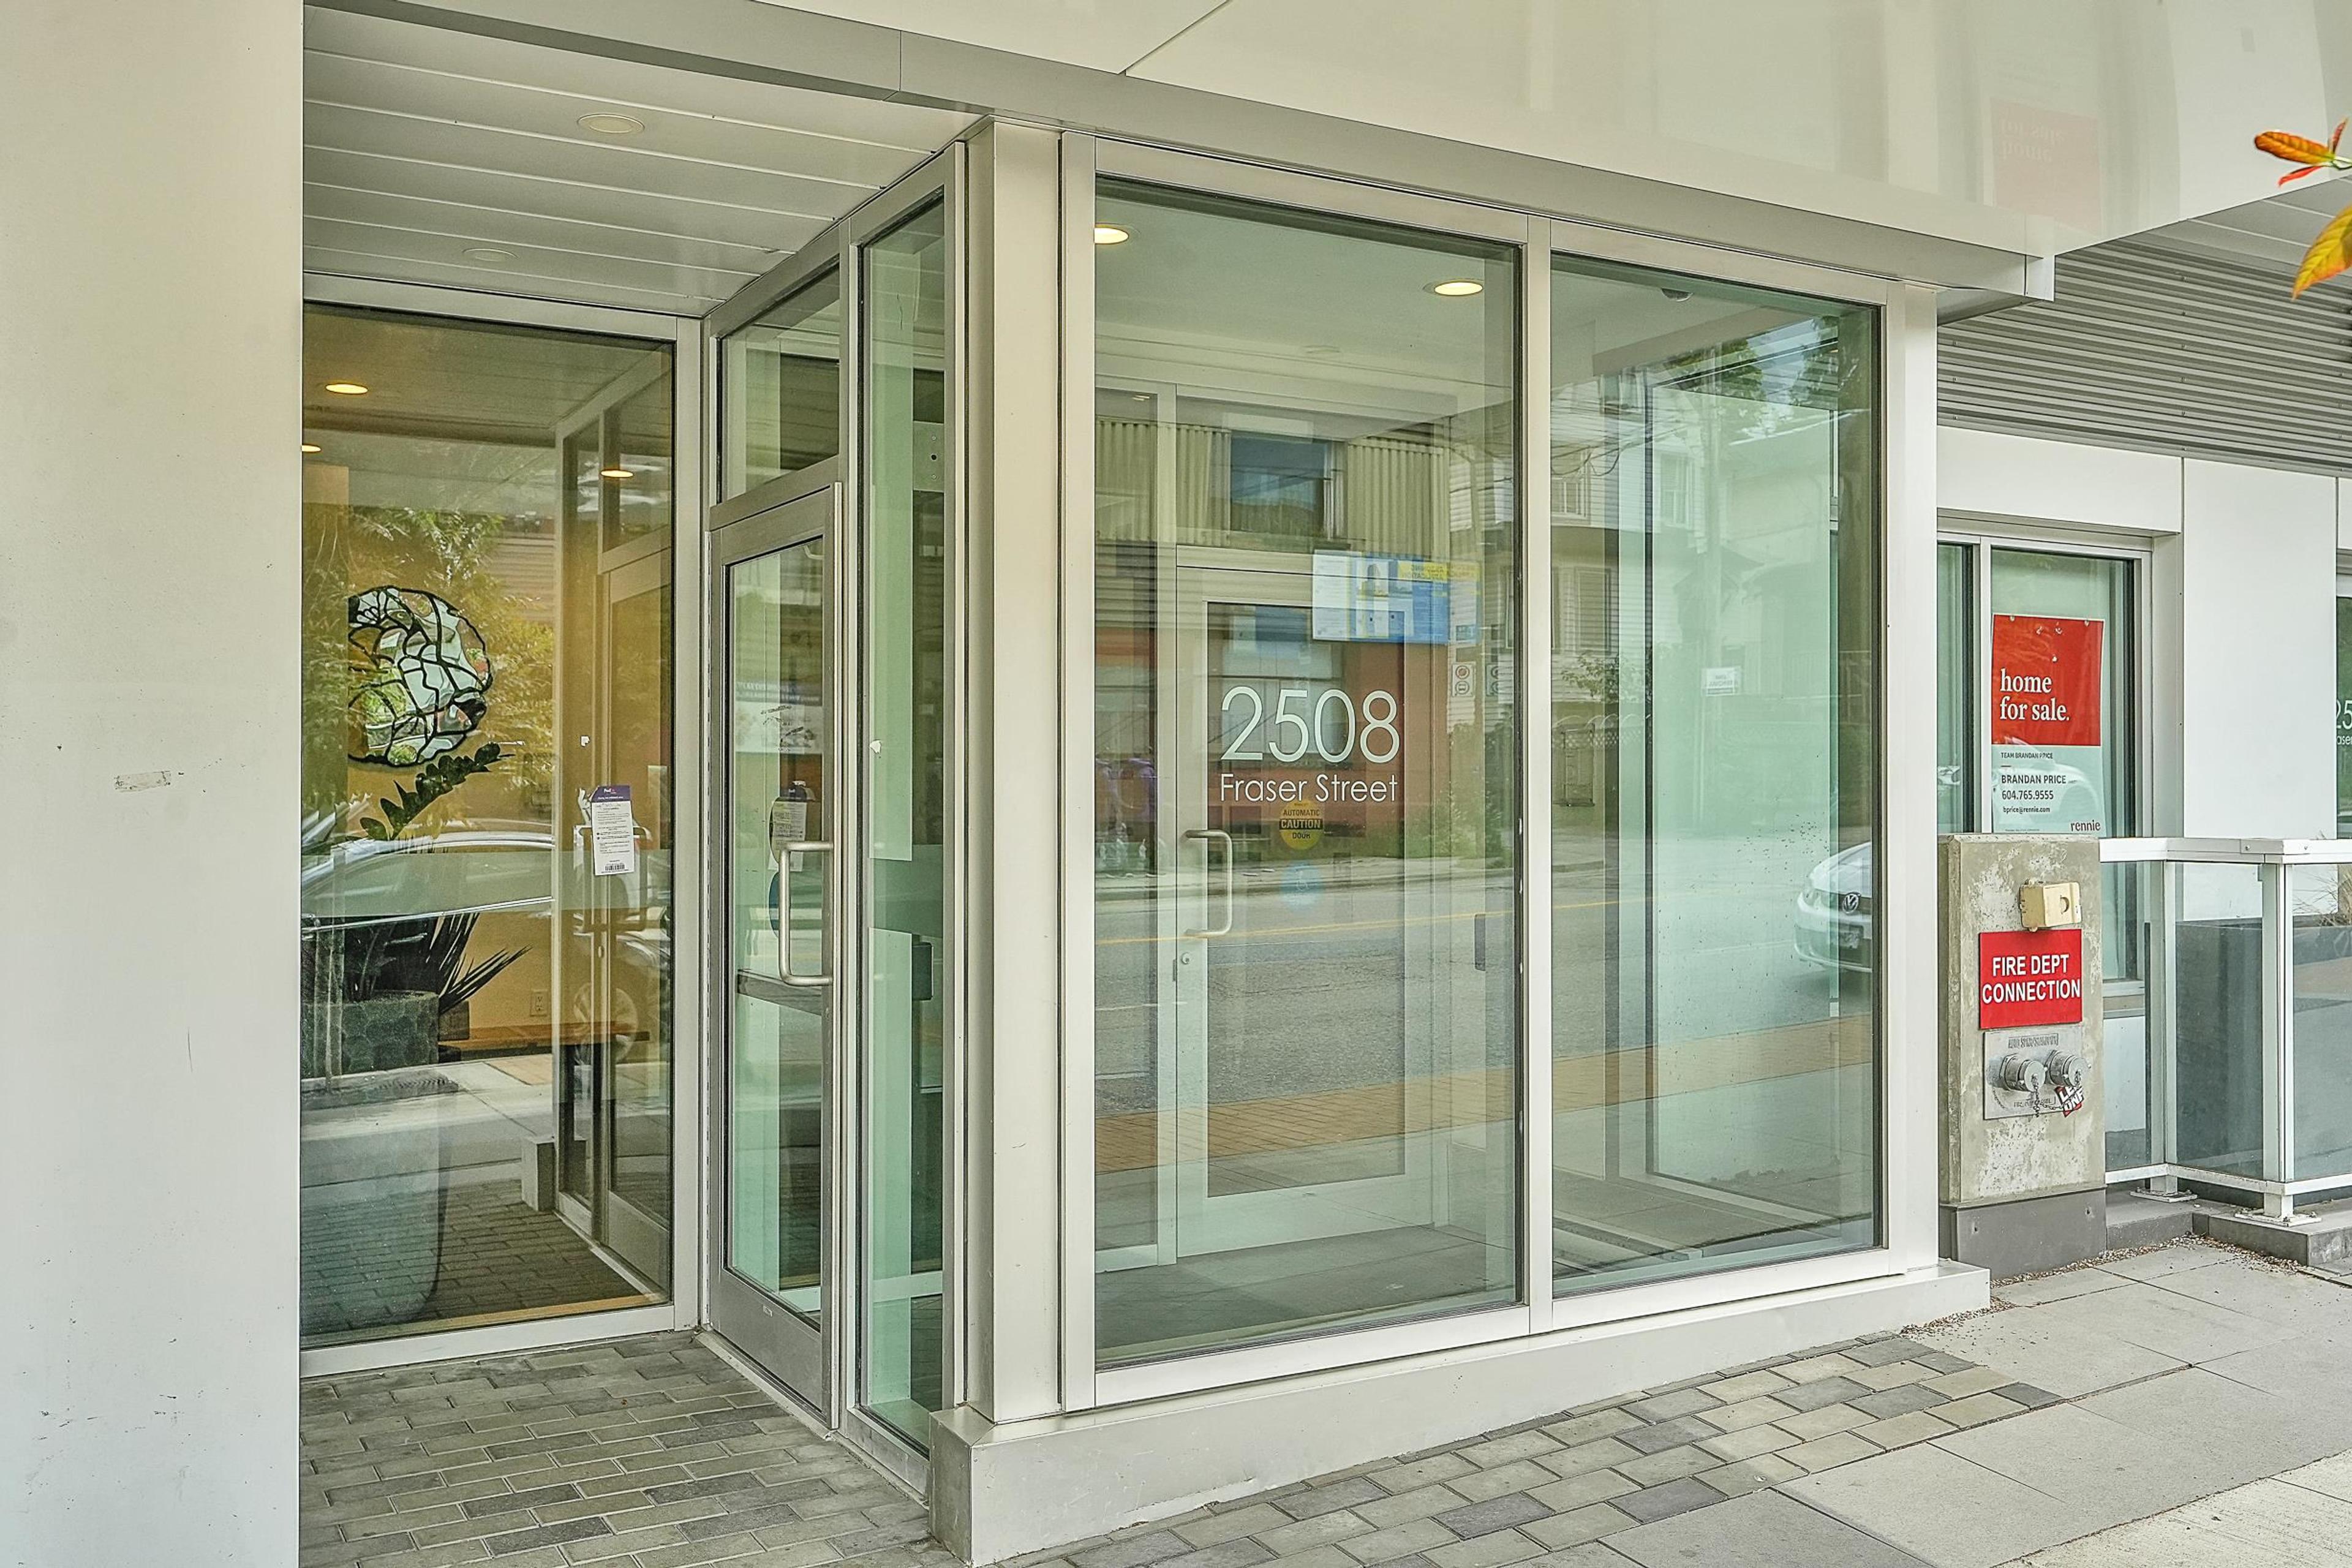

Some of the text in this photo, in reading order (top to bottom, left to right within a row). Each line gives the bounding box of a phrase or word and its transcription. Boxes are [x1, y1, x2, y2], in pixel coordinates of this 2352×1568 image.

[2000, 668, 2052, 693] home
[2000, 695, 2070, 721] for sale.
[1220, 686, 1400, 764] 2508
[1220, 774, 1398, 802] Fraser Street
[2001, 775, 2042, 784] BRANDAN
[2043, 775, 2067, 784] PRICE
[2002, 790, 2054, 800] 604.765.9555
[2003, 807, 2051, 815] bprice@rennie.com
[1281, 819, 1321, 829] CAUTION
[2070, 820, 2101, 832] rennie
[1992, 954, 2070, 976] FIRE DEPT
[1981, 978, 2081, 1003] CONNECTION
